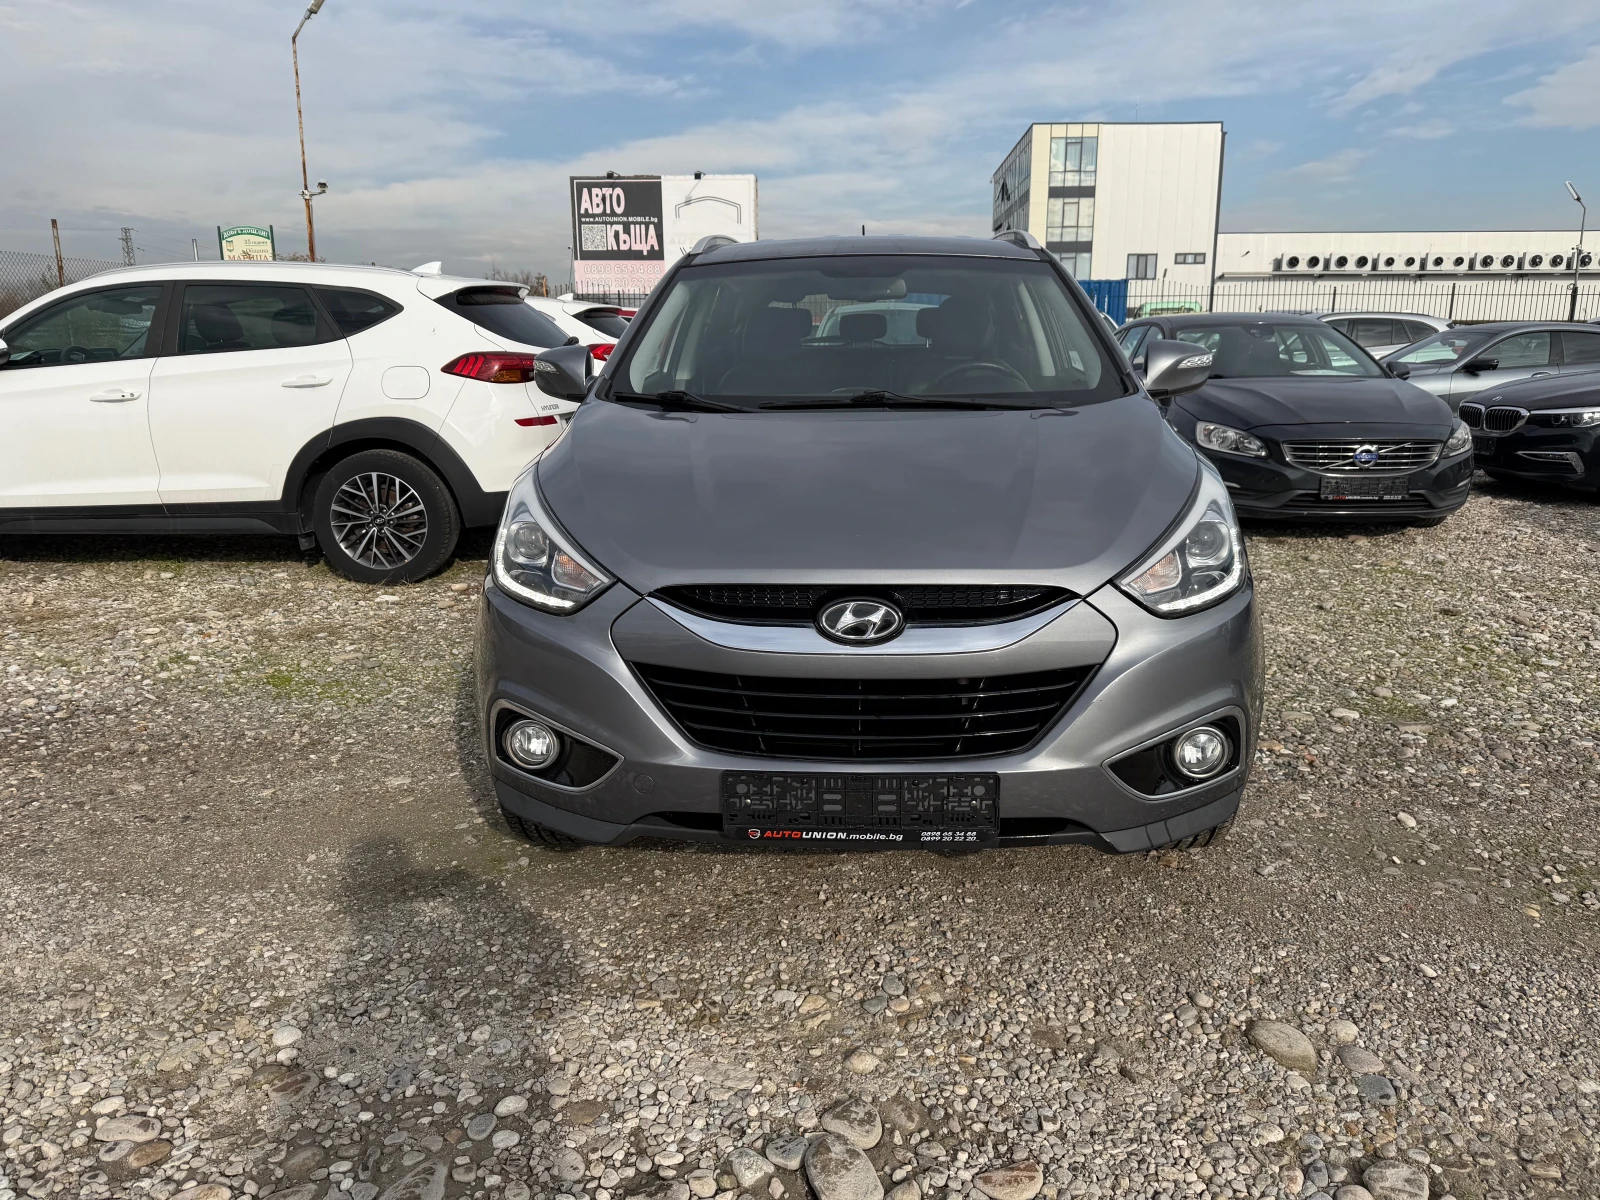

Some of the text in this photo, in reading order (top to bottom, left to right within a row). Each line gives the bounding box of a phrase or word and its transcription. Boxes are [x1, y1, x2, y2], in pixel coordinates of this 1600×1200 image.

[580, 187, 625, 214] АВТО
[607, 224, 659, 255] КЪЩА
[584, 264, 661, 274] 0898 65 34 88
[585, 278, 612, 288] 0899
[615, 278, 628, 288] 20
[631, 278, 645, 288] 22
[763, 830, 904, 841] AUTOUNION.mobile.bg
